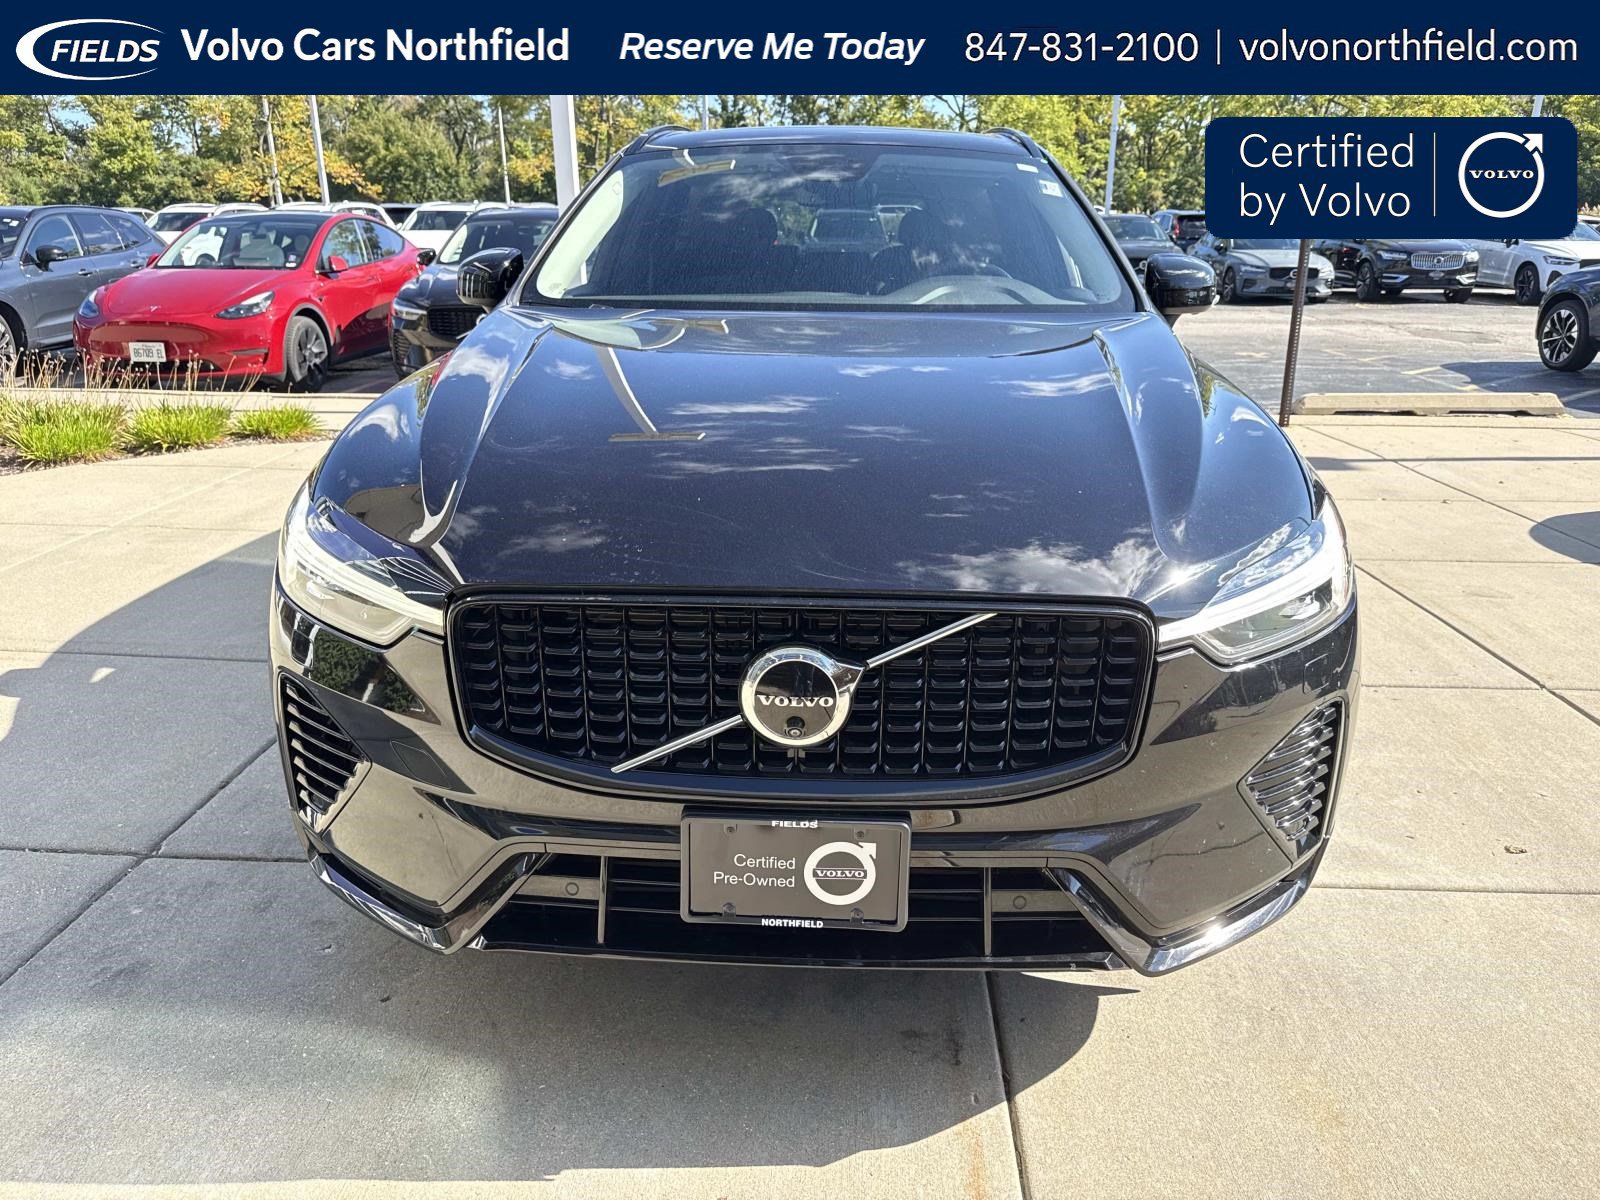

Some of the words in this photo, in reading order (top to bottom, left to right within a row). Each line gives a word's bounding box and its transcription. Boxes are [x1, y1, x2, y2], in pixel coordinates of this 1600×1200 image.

[756, 694, 834, 707] VOLVO
[771, 820, 819, 829] FIELDS
[733, 853, 796, 870] Certified
[712, 871, 796, 888] Pre-Owned
[815, 869, 865, 878] VOLVO
[761, 917, 824, 929] NORTHFIELD
